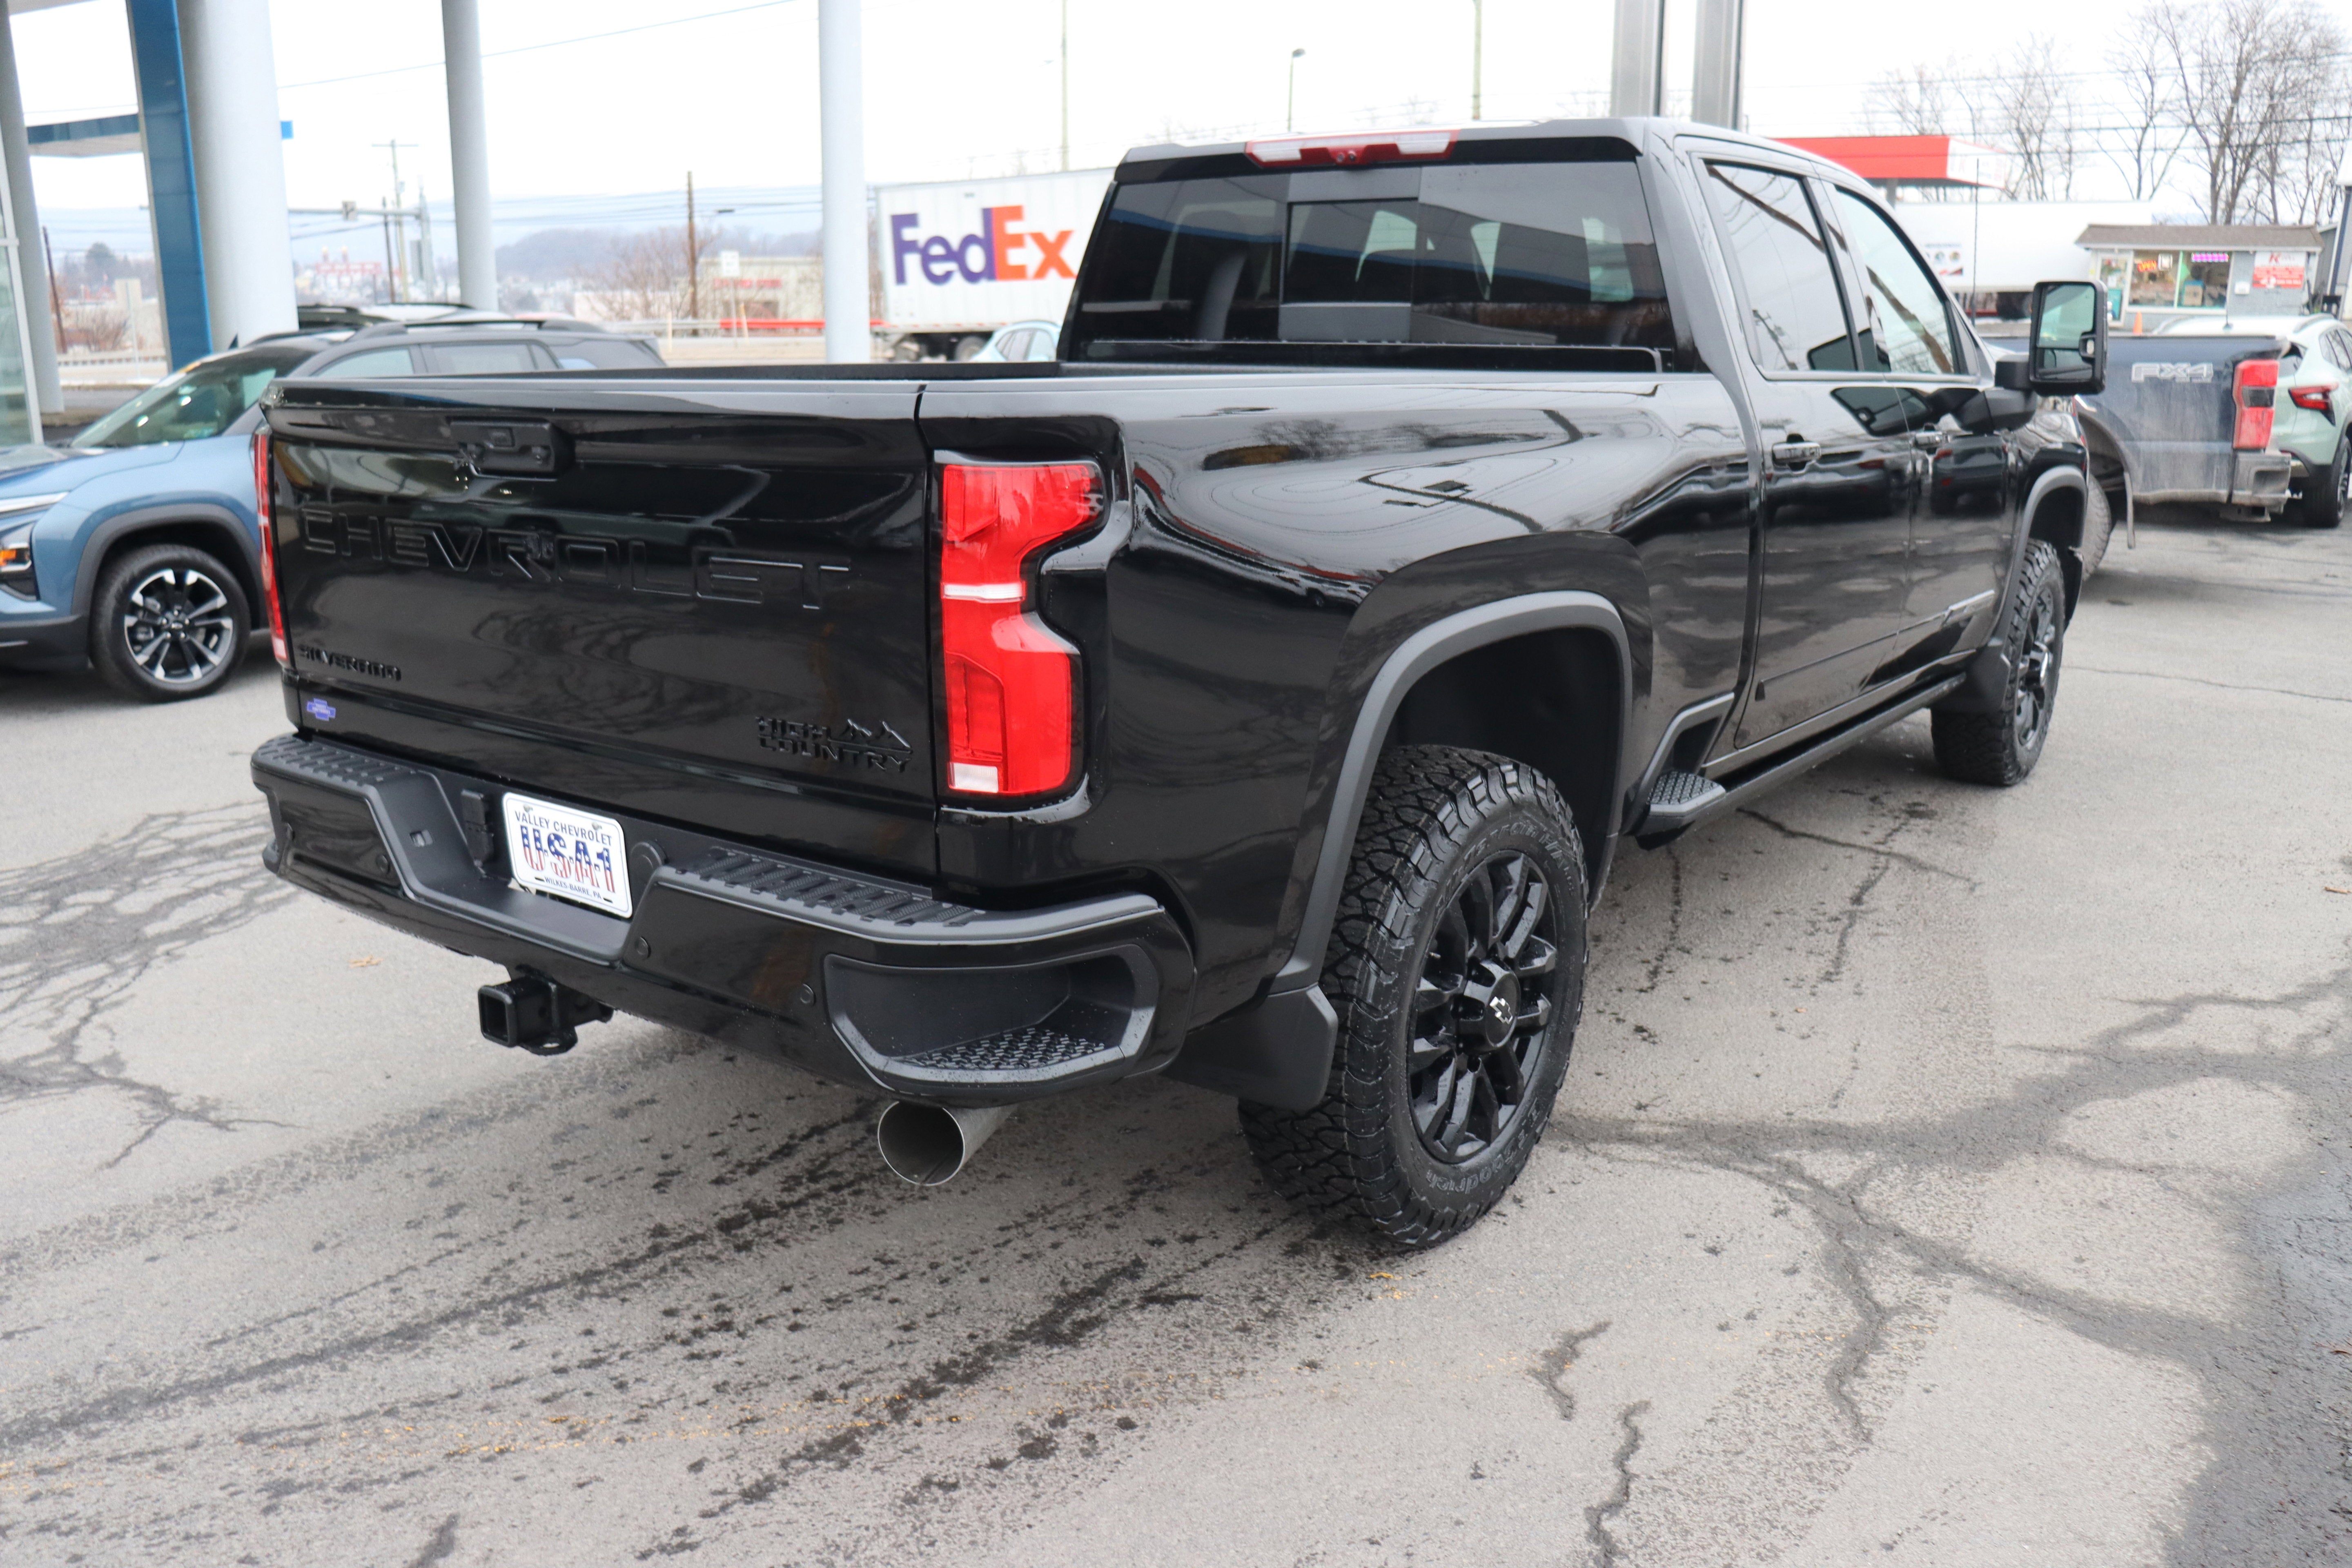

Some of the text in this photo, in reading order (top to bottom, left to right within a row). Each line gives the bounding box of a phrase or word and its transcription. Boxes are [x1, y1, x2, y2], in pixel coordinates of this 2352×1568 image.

[891, 205, 1078, 285] FedEx
[2132, 363, 2213, 383] FX4
[301, 508, 851, 609] CHEVROLET
[756, 716, 831, 739] HIGH
[759, 735, 911, 772] COUNTRY
[514, 810, 612, 846] VALLEY CHEVROLET
[593, 891, 602, 900] PA
